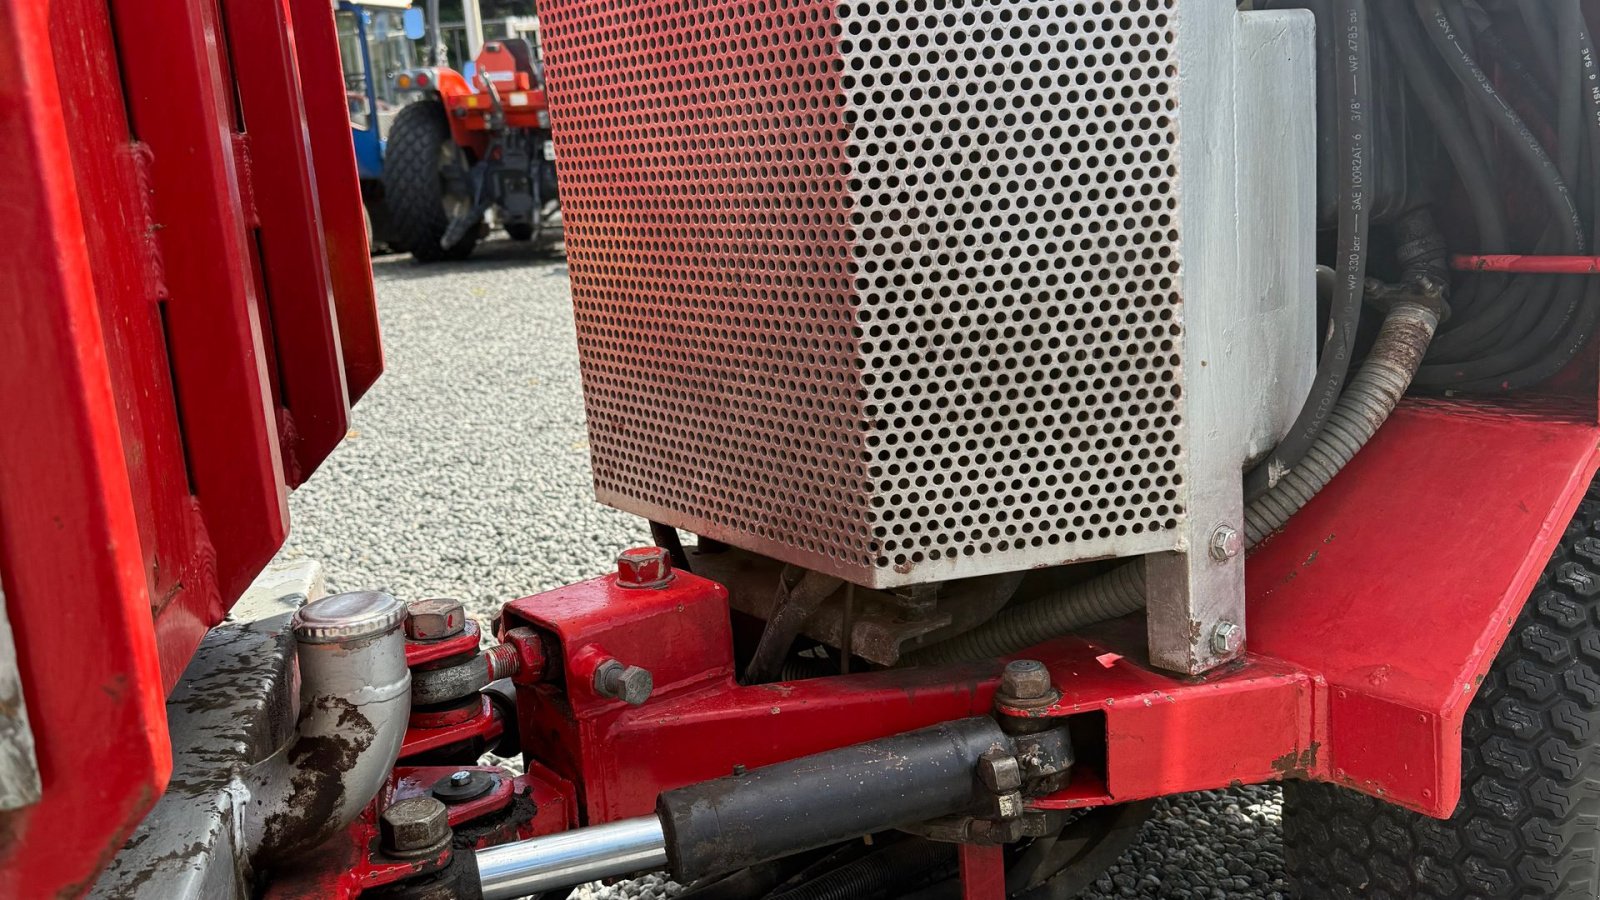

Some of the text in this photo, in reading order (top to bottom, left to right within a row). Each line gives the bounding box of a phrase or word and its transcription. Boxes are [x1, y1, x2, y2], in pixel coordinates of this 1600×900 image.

[1347, 8, 1358, 23] psi
[1347, 25, 1358, 52] 4785
[1348, 55, 1359, 72] WP
[1581, 47, 1593, 68] SAE
[1350, 98, 1361, 121] 3/8"
[1351, 192, 1362, 210] SAE
[1350, 235, 1361, 251] bar
[1349, 254, 1359, 271] 330
[1348, 274, 1358, 290] WP
